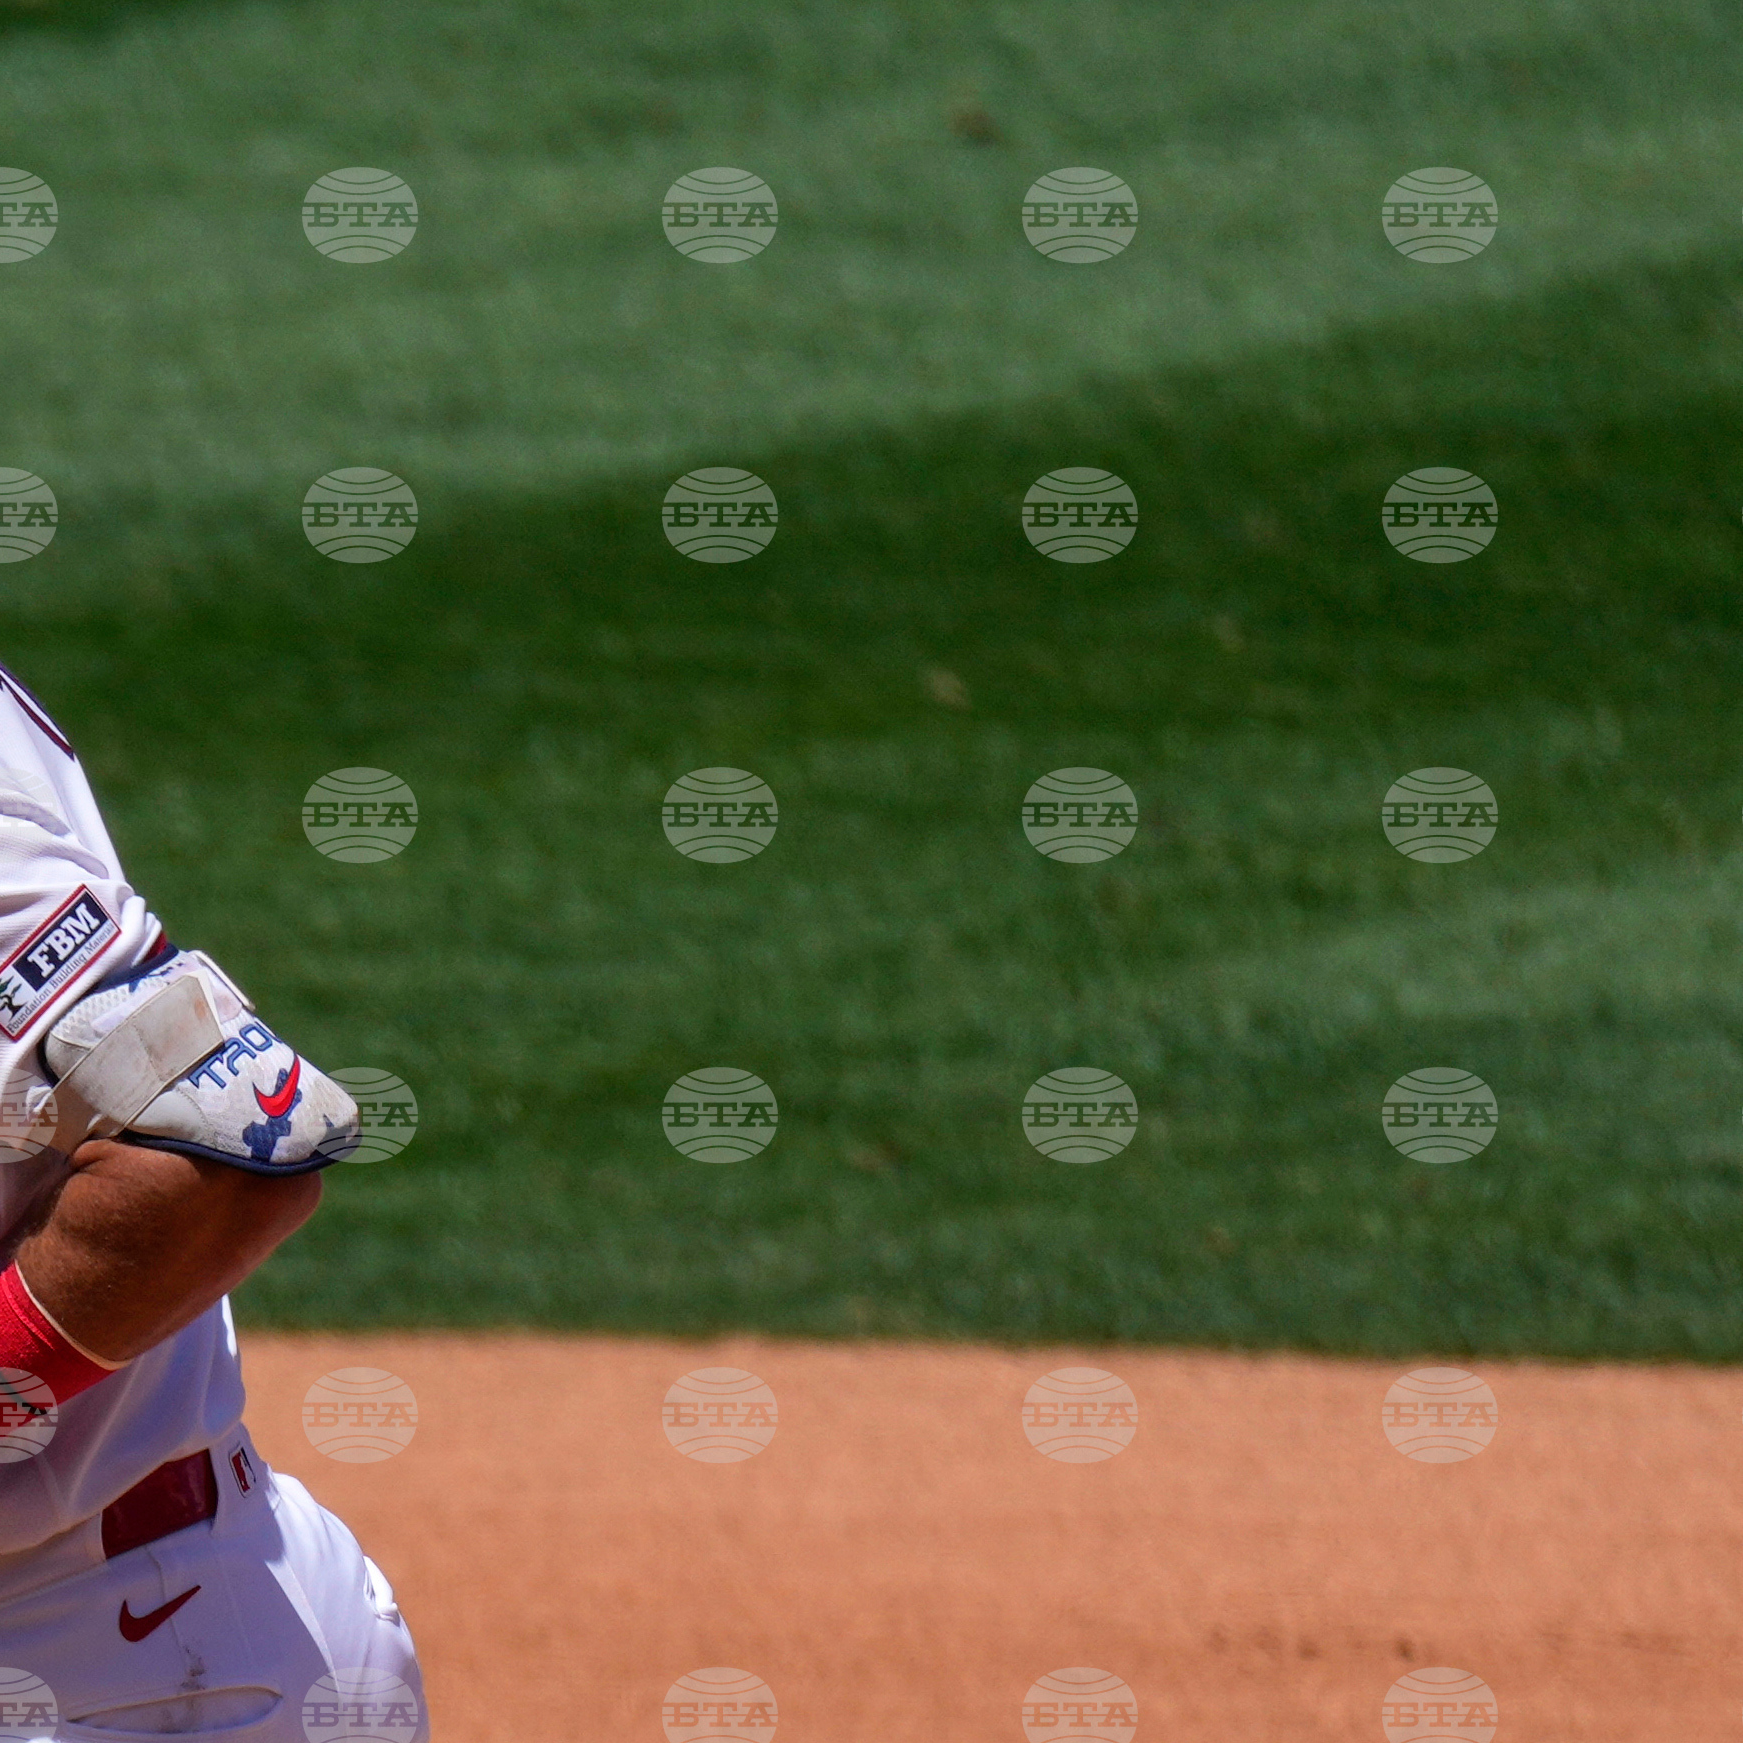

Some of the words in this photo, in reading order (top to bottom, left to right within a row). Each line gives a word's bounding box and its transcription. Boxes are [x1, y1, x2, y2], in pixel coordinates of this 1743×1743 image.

[26, 902, 100, 979] FBM
[6, 988, 52, 1034] Foundation
[49, 953, 87, 990] Building
[186, 1020, 281, 1090] TRO
